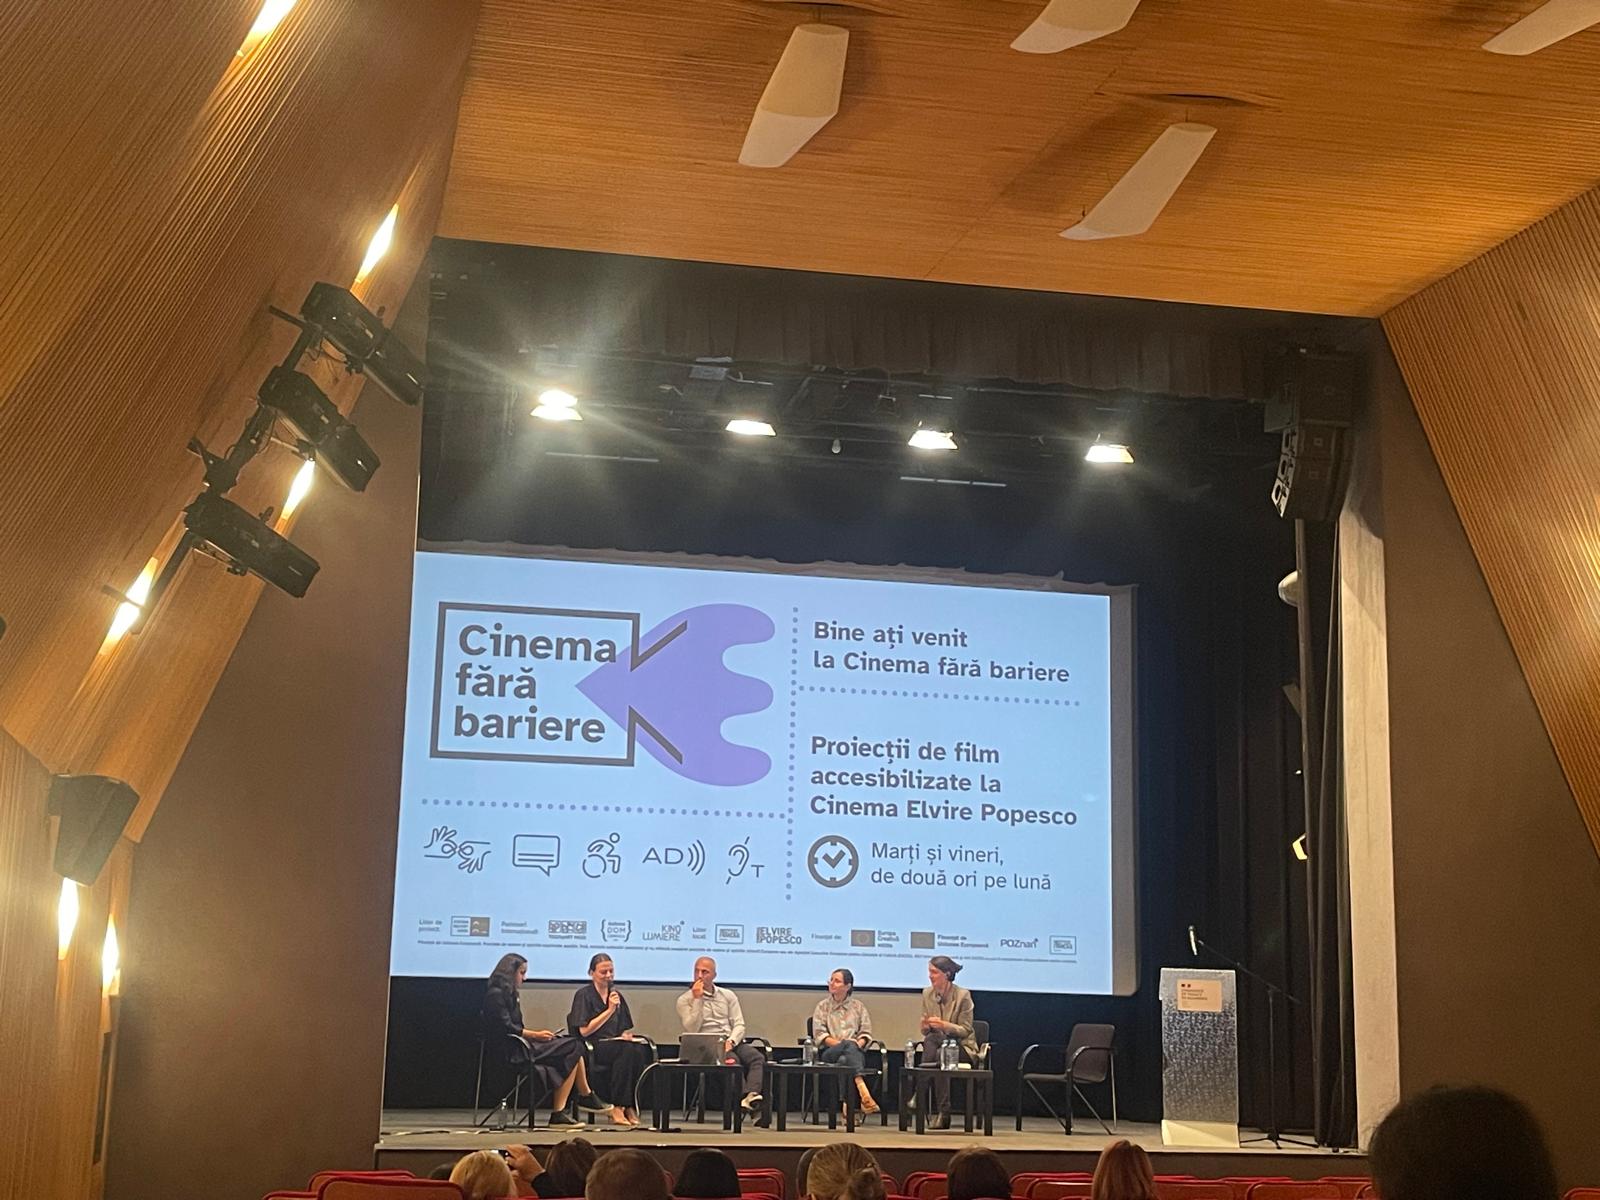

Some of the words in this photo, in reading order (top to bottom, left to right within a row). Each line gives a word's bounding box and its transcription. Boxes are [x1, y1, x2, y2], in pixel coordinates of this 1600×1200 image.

[459, 622, 617, 663] Cinema
[814, 621, 865, 642] Bine
[873, 625, 904, 650] ați
[911, 628, 968, 648] venit
[455, 663, 537, 699] fără
[814, 651, 835, 669] la
[843, 651, 930, 675] Cinema
[938, 657, 981, 678] fără
[990, 661, 1070, 682] bariere
[454, 705, 606, 743] bariere
[811, 736, 910, 765] Proiecții
[918, 742, 946, 761] de
[954, 742, 1000, 764] film
[811, 768, 972, 791] accesibilizate
[980, 775, 1001, 793] la
[810, 794, 898, 818] Cinema
[907, 800, 973, 821] Elvire
[981, 804, 1077, 827] Popesco
[642, 847, 684, 865] AD
[872, 843, 920, 865] Marți
[927, 848, 942, 866] și
[949, 848, 1004, 866] vineri,
[871, 868, 895, 884] de
[901, 870, 946, 886] două
[953, 871, 977, 887] ori
[985, 876, 1007, 892] pe
[1014, 874, 1051, 891] lună
[759, 936, 802, 945] POPESCO
[761, 927, 793, 937] ELVIRE
